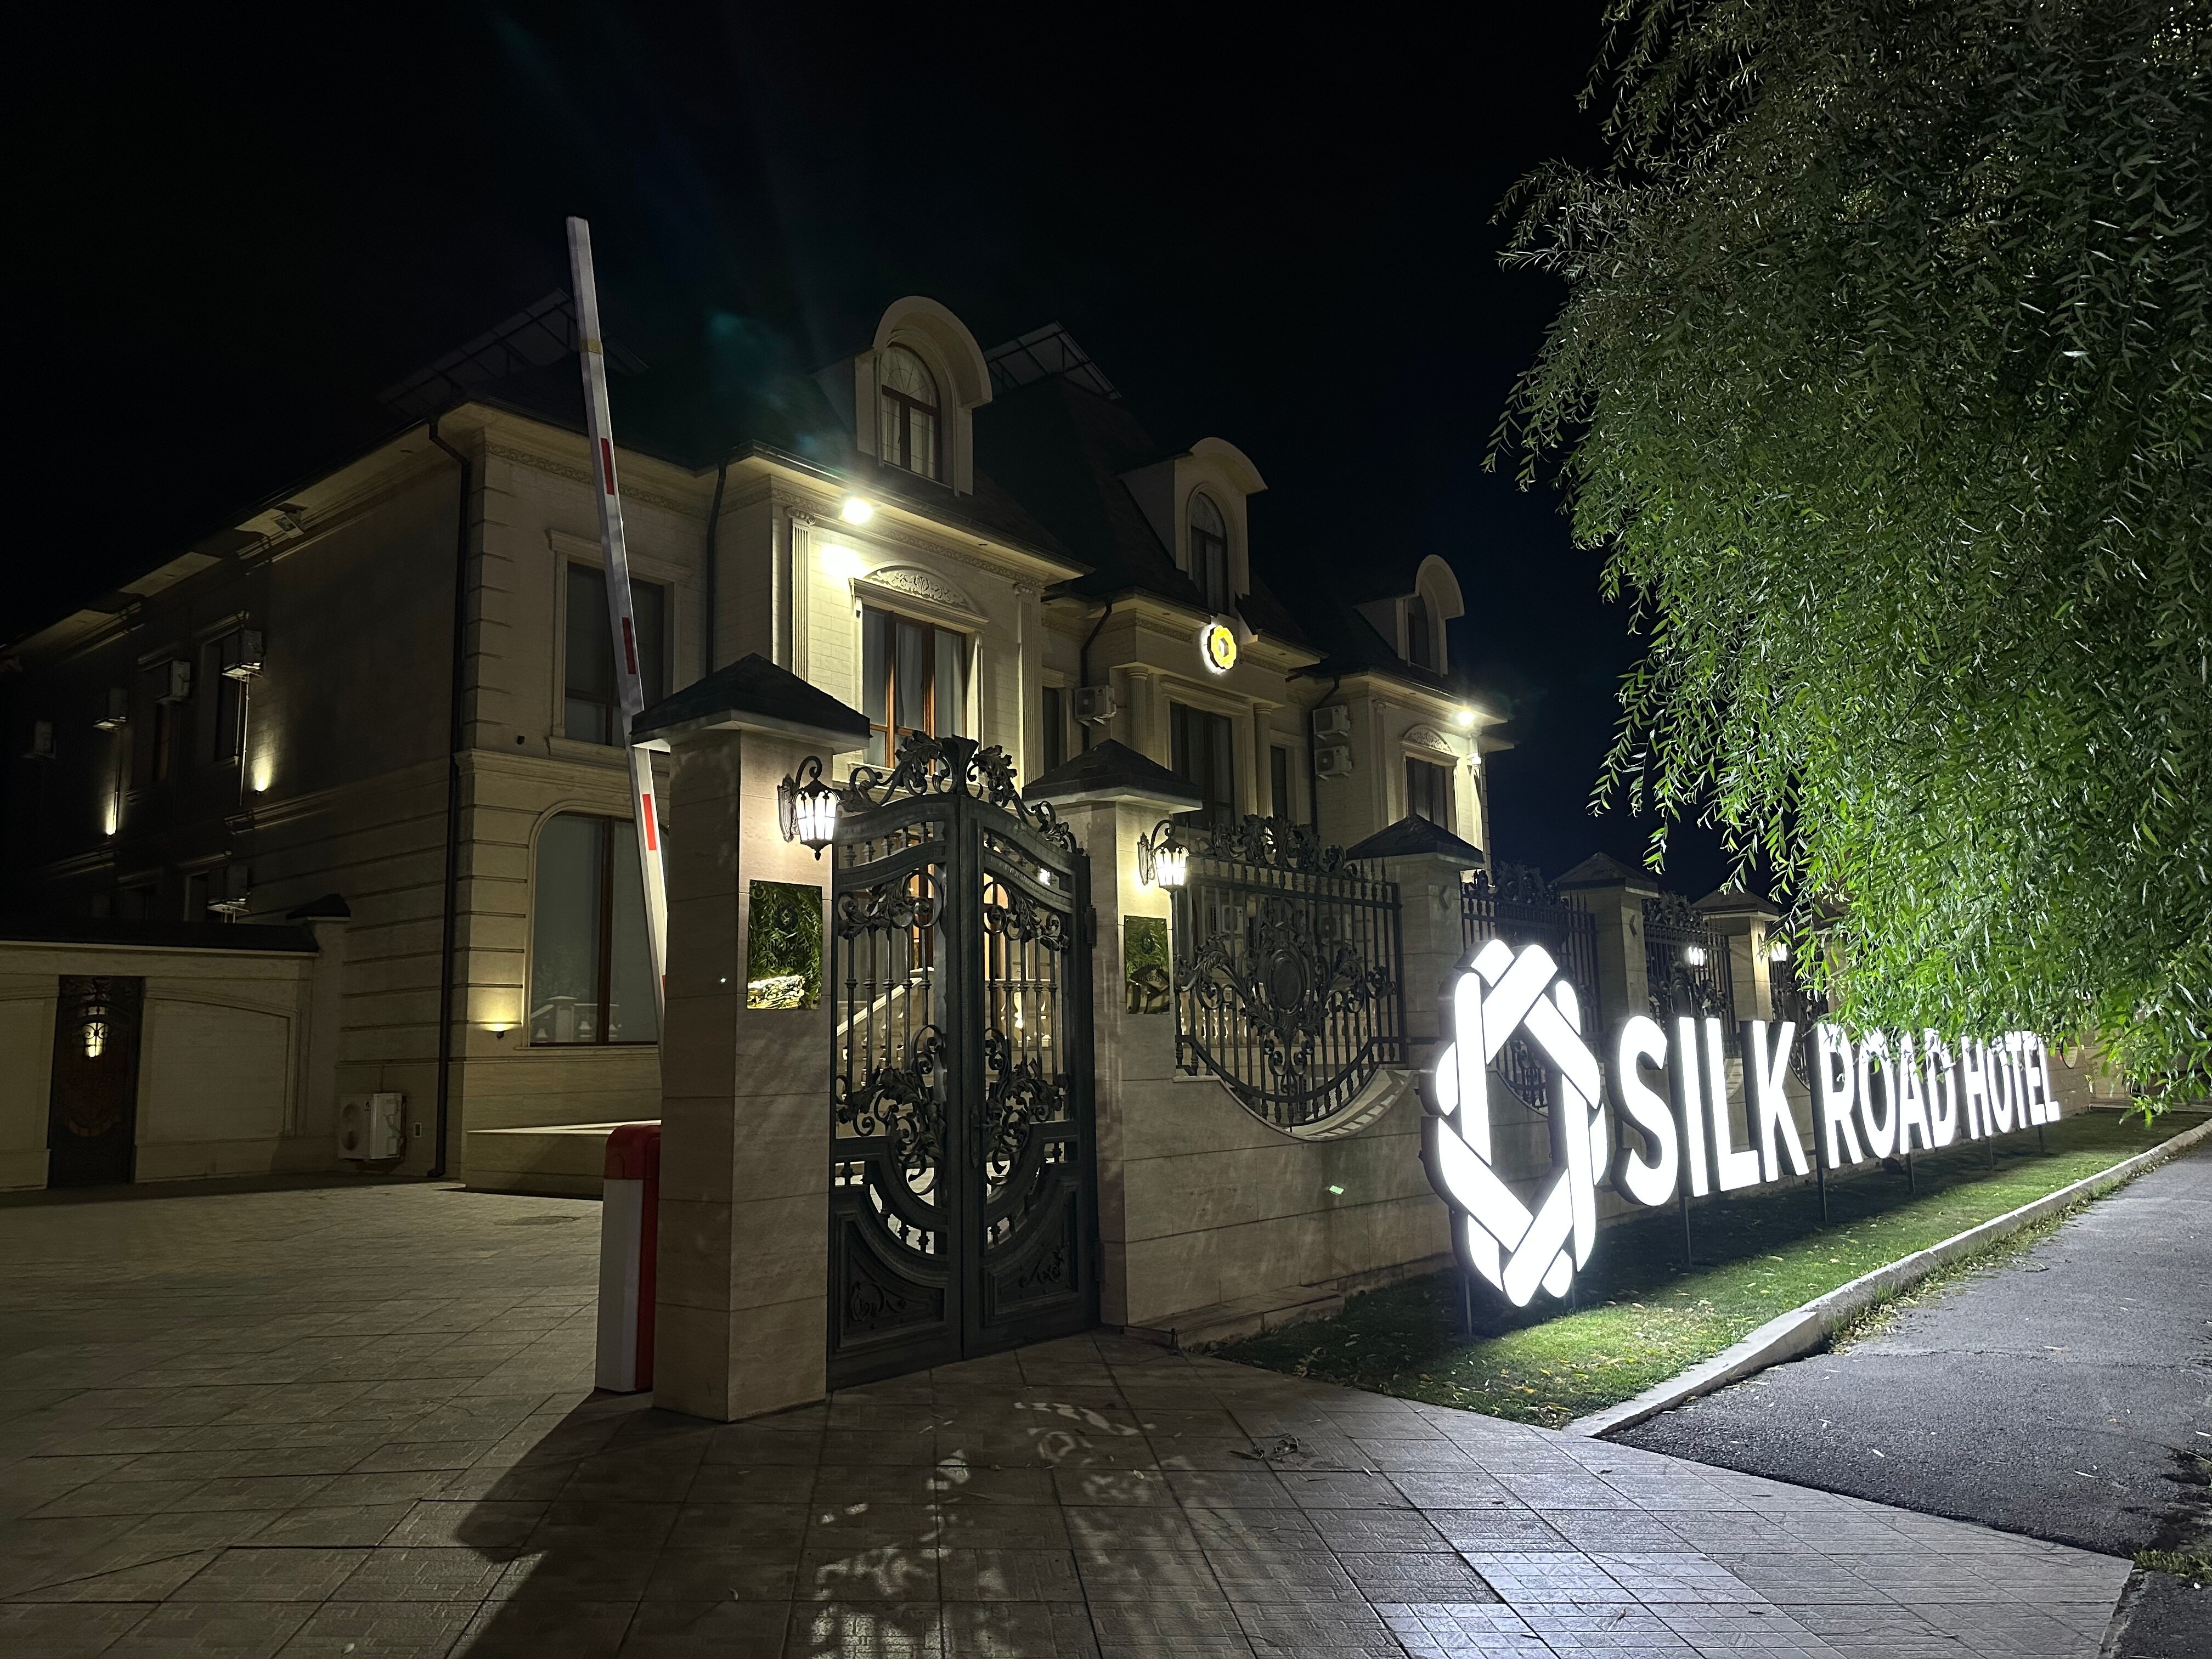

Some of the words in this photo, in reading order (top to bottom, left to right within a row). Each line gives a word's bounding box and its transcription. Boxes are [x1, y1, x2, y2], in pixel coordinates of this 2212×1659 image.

[1618, 1015, 1809, 1206] SILK
[1816, 1021, 1956, 1169] ROAD
[1960, 1030, 2061, 1141] HOTEL
